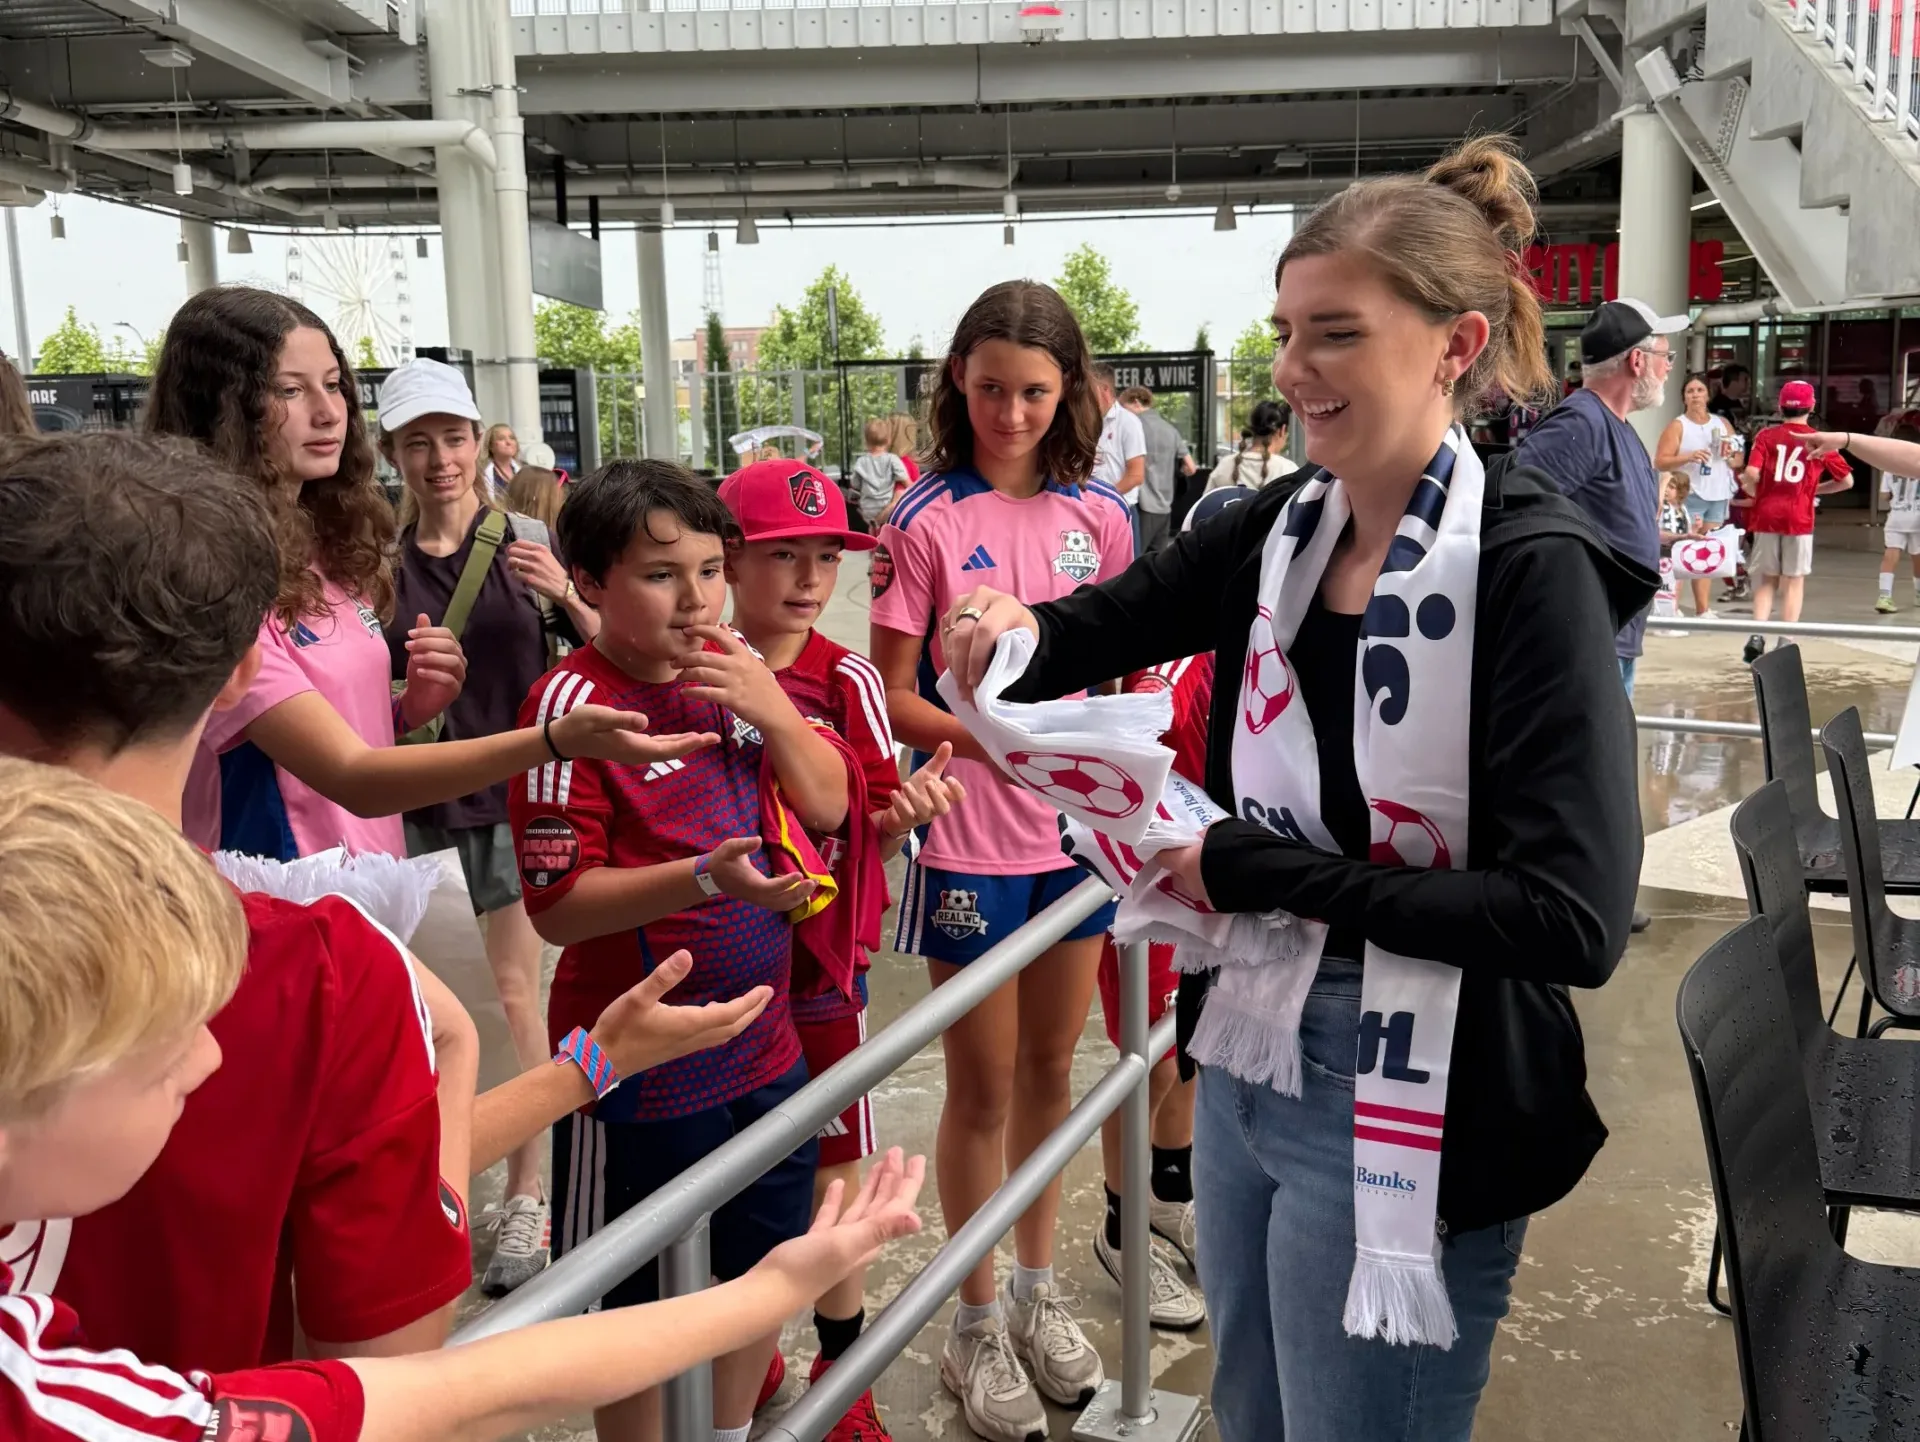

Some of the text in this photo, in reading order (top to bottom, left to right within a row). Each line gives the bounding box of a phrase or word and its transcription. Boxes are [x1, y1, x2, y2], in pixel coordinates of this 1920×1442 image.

[1114, 365, 1195, 387] EER & WINE
[1773, 443, 1806, 484] 16
[1061, 553, 1095, 566] REAL WC
[1173, 780, 1199, 806] Banks
[1188, 805, 1213, 827] oyal
[938, 911, 979, 925] REAL WC
[1356, 1166, 1417, 1192] Banks
